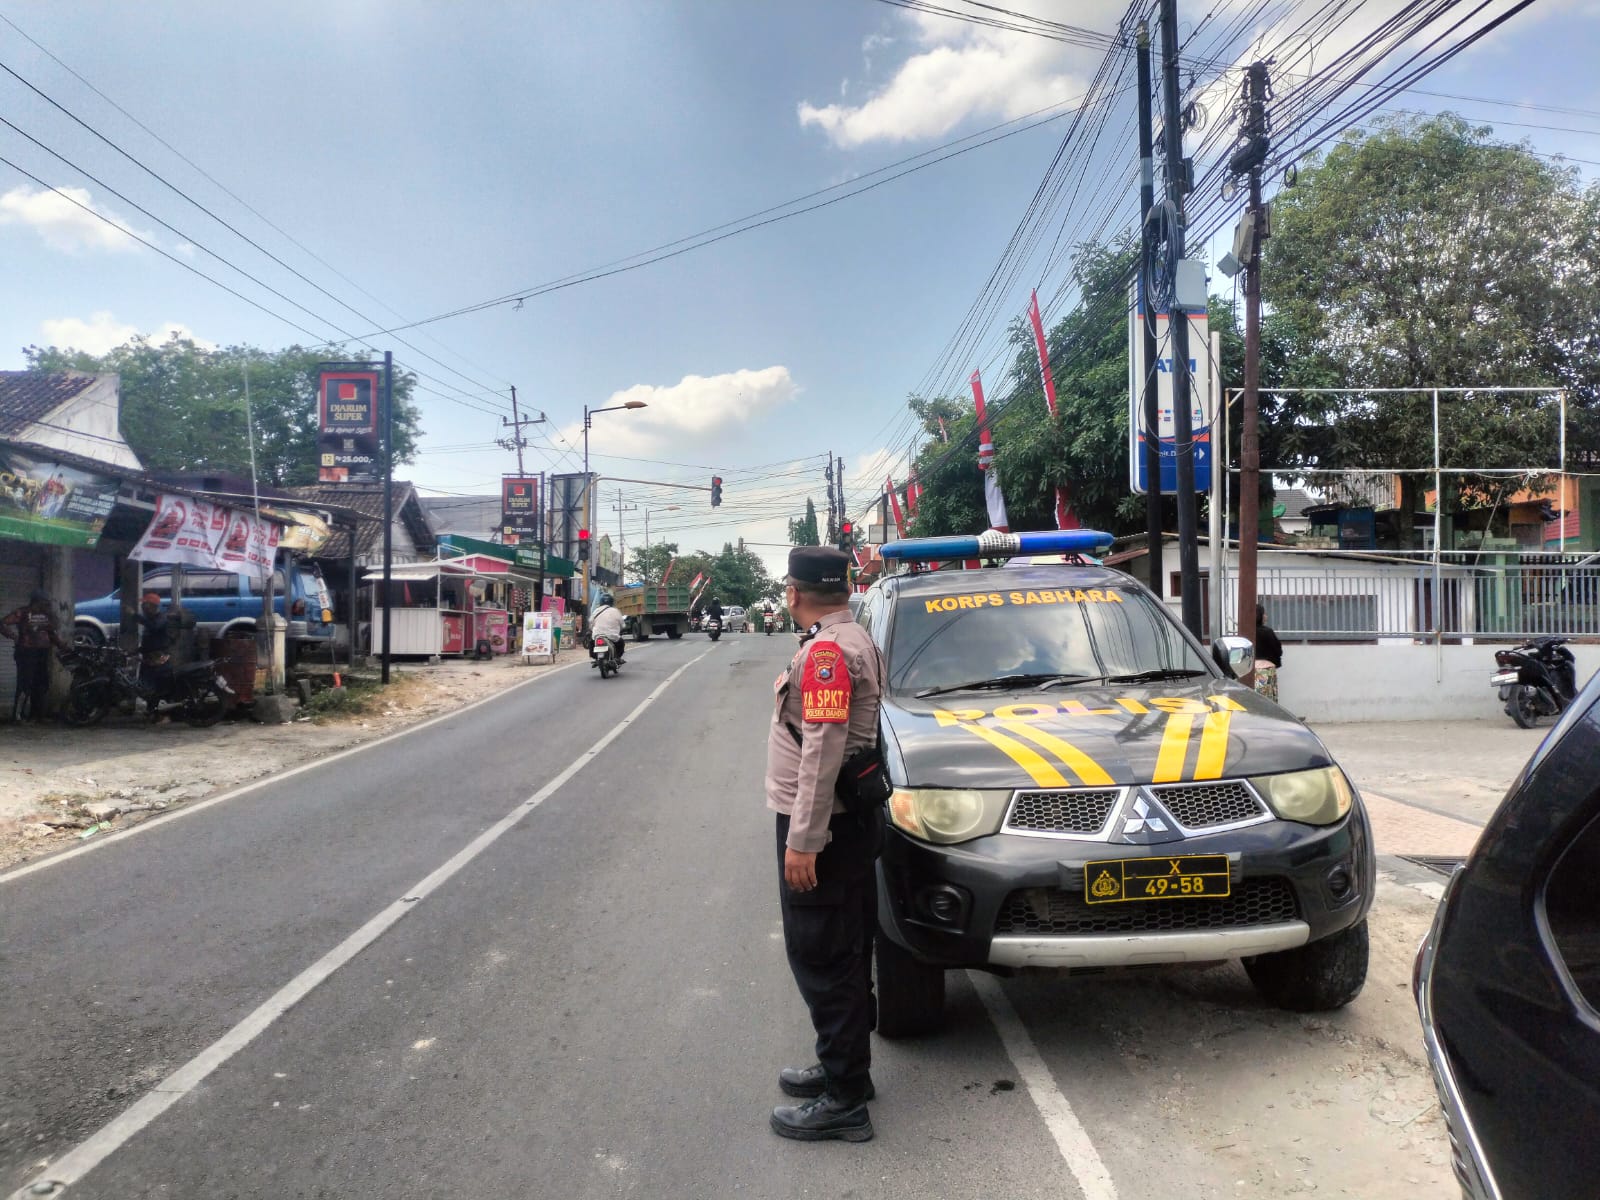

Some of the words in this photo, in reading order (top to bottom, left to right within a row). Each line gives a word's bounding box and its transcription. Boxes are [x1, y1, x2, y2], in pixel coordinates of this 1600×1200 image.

[334, 412, 363, 421] SUPER
[925, 592, 1004, 613] KORPS
[1009, 589, 1123, 606] SABHARA
[817, 689, 844, 709] SPKT
[932, 694, 1248, 728] POLISI
[1169, 860, 1181, 874] X
[1145, 876, 1204, 896] 49-58
